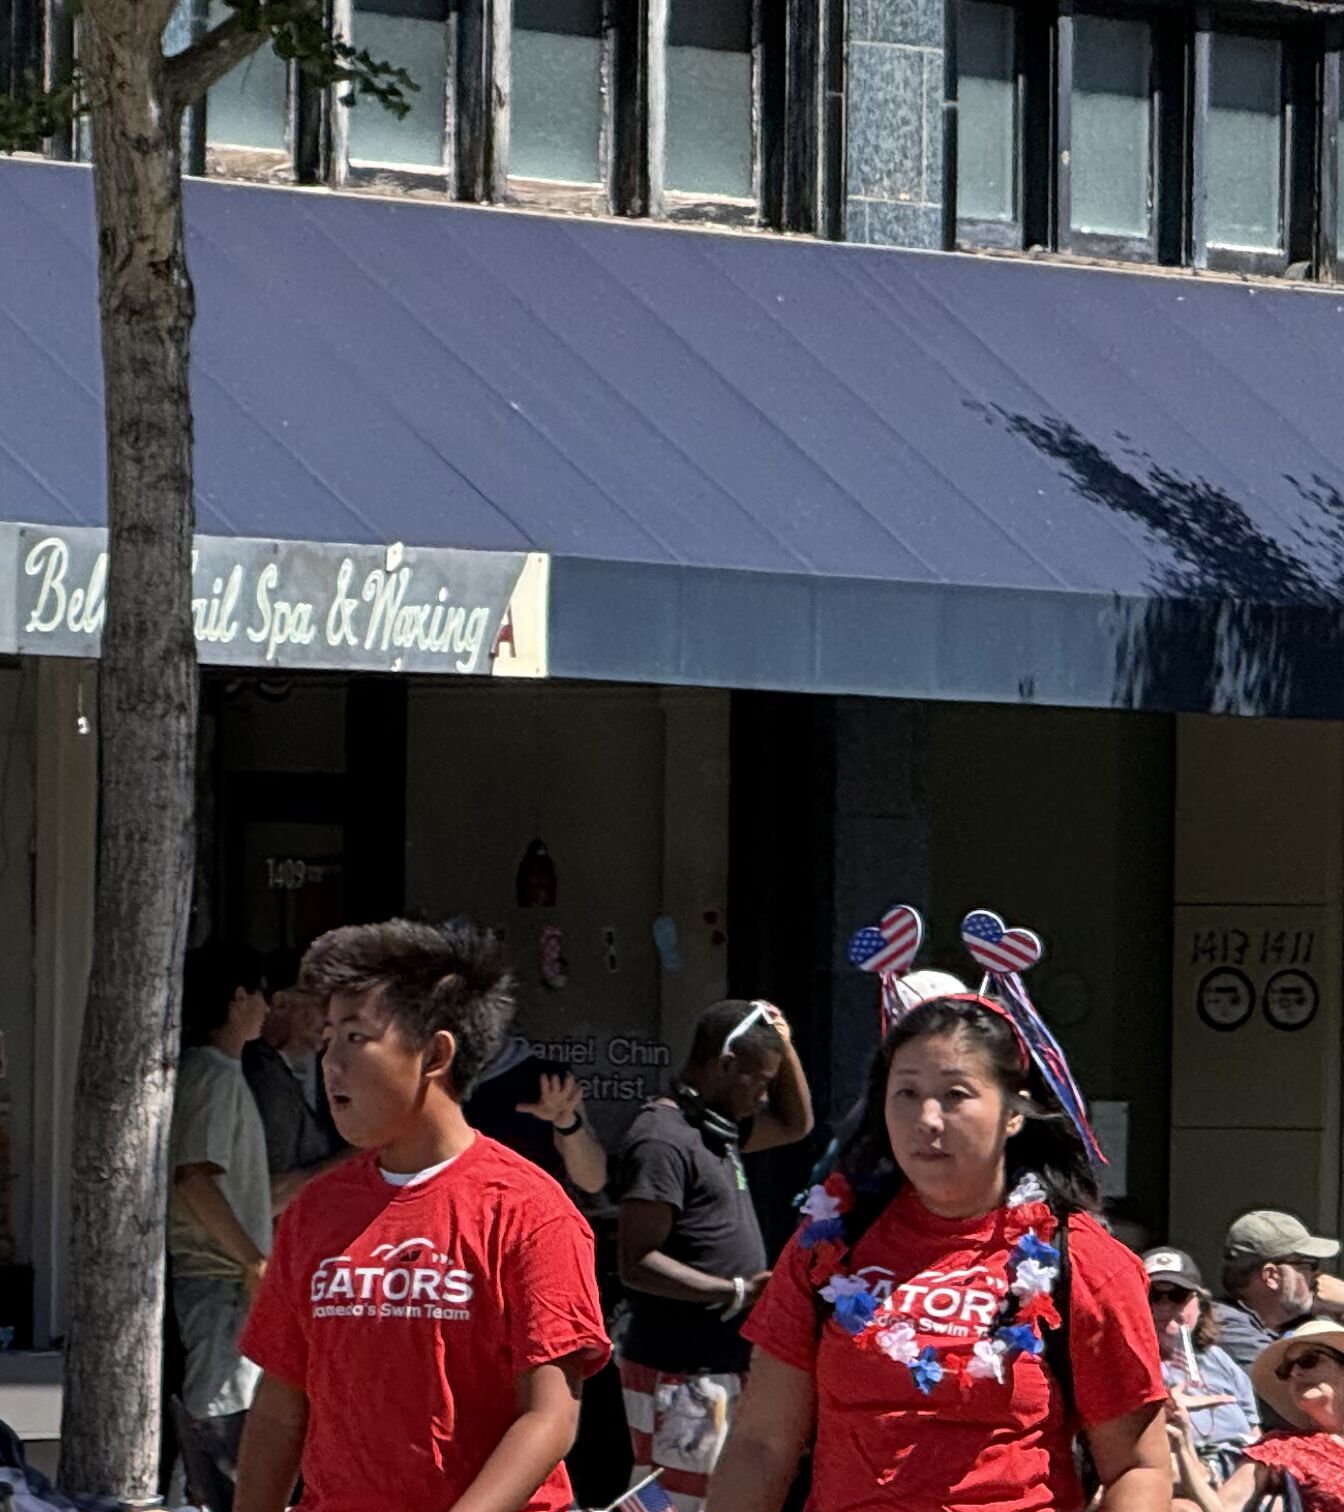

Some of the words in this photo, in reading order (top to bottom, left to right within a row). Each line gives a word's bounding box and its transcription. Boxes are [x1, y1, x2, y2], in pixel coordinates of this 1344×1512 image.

[24, 537, 106, 634] Bel
[191, 549, 243, 643] ail
[246, 562, 316, 661] Spa
[326, 557, 358, 647] &
[360, 566, 489, 672] Waxing
[265, 858, 307, 889] 1409
[1190, 929, 1250, 965] 1413
[1260, 930, 1315, 964] 1411
[608, 1038, 671, 1066] Chin
[576, 1075, 645, 1101] etrist
[310, 1267, 475, 1304] GATORS
[380, 1302, 421, 1319] Swim
[424, 1303, 471, 1321] Team
[919, 1317, 970, 1338] Swim
